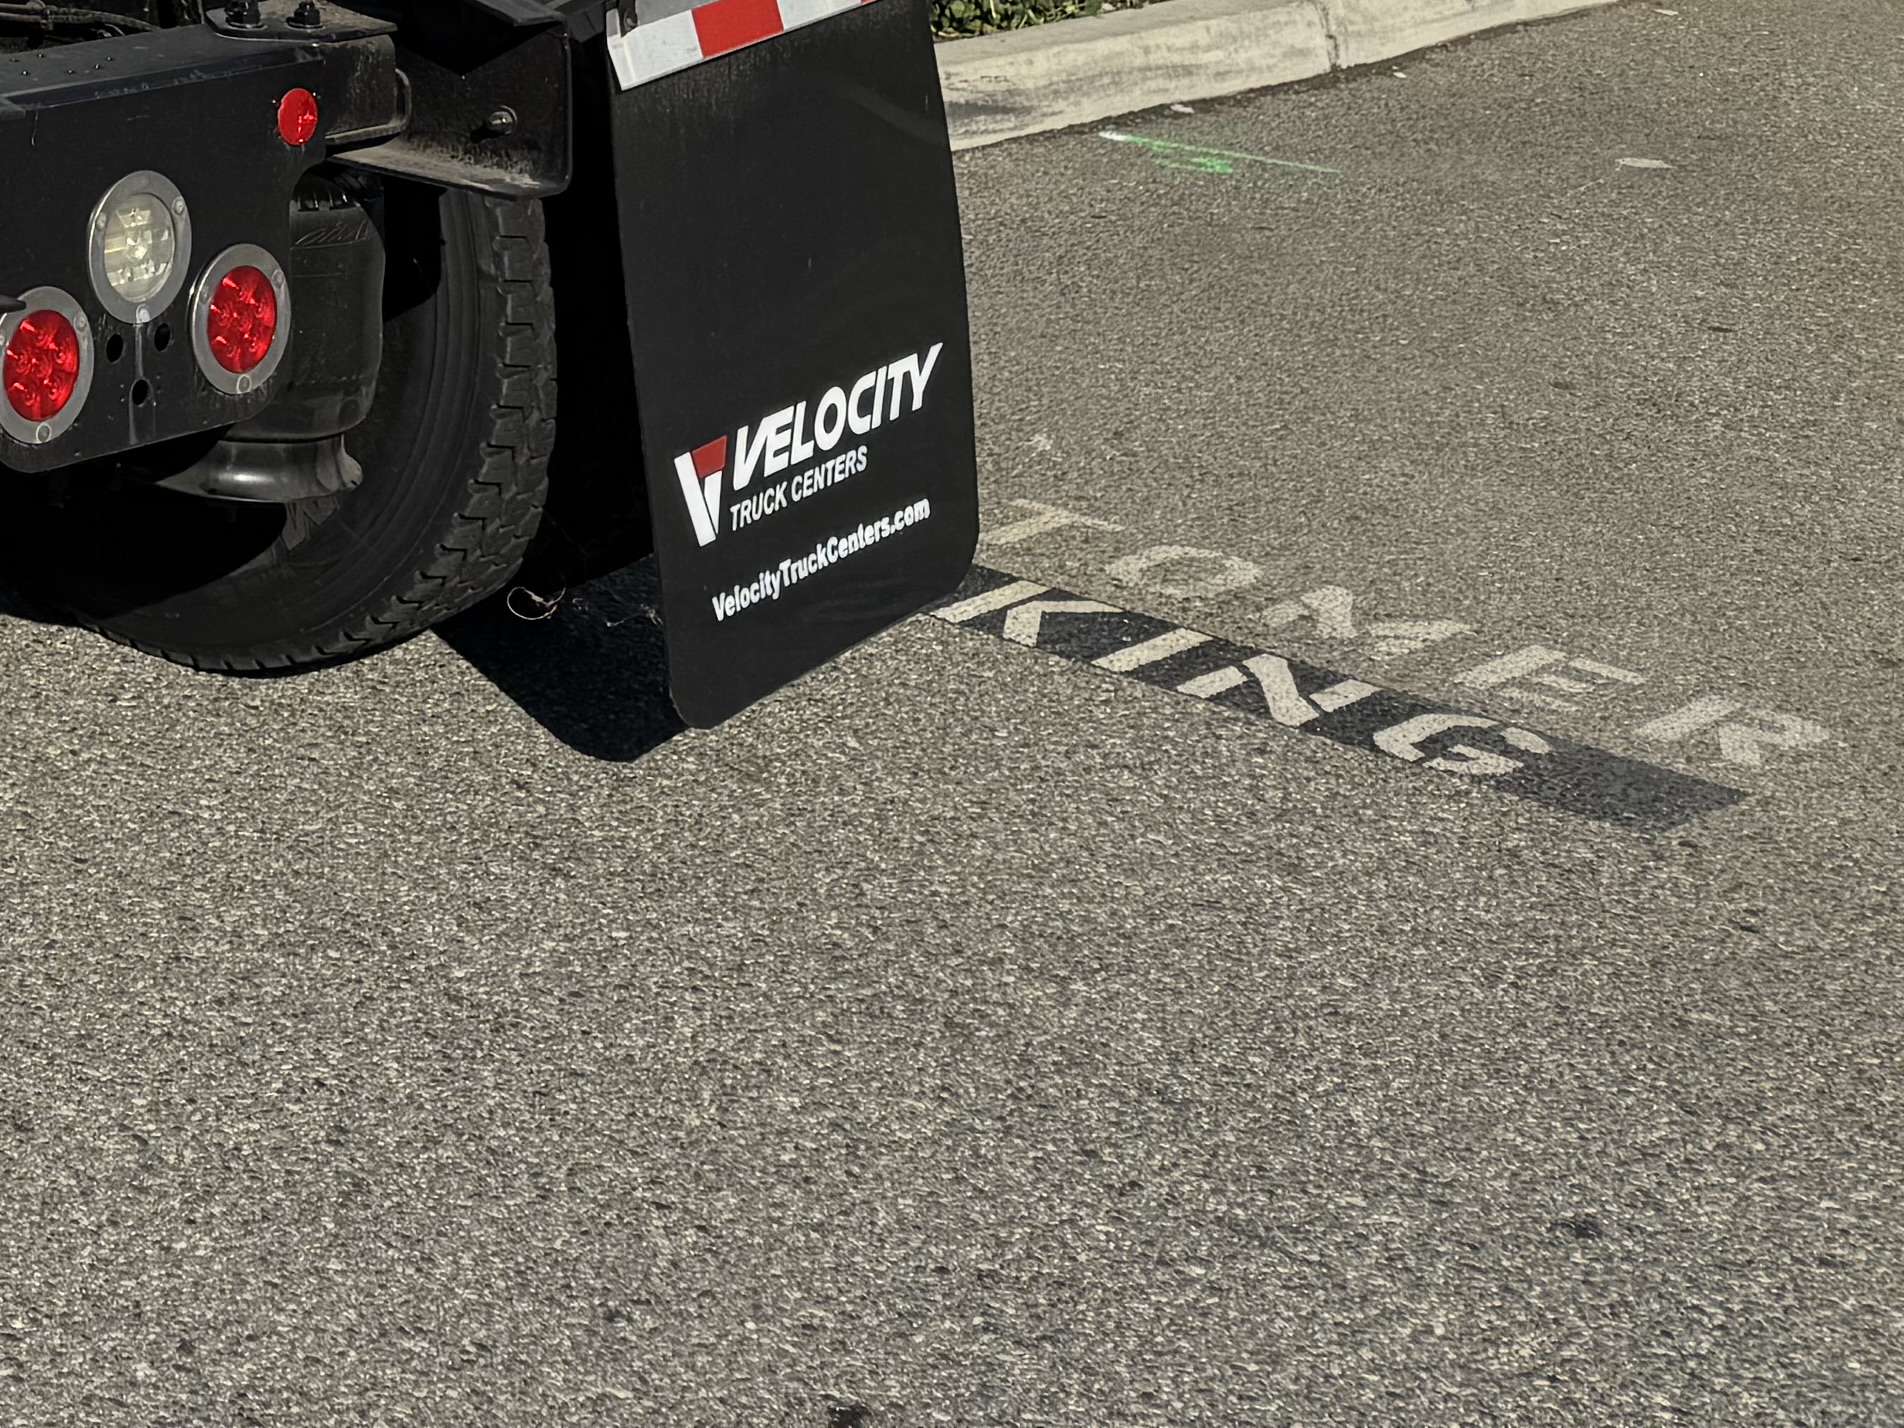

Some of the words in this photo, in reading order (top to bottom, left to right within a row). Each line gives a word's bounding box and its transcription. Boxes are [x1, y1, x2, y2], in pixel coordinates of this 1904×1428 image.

[732, 342, 944, 491] VELOCITY
[730, 481, 787, 531] TRUCK
[792, 445, 868, 503] CENTERS
[712, 498, 931, 622] VelocityTruckCenters.com
[929, 580, 1552, 778] KING
